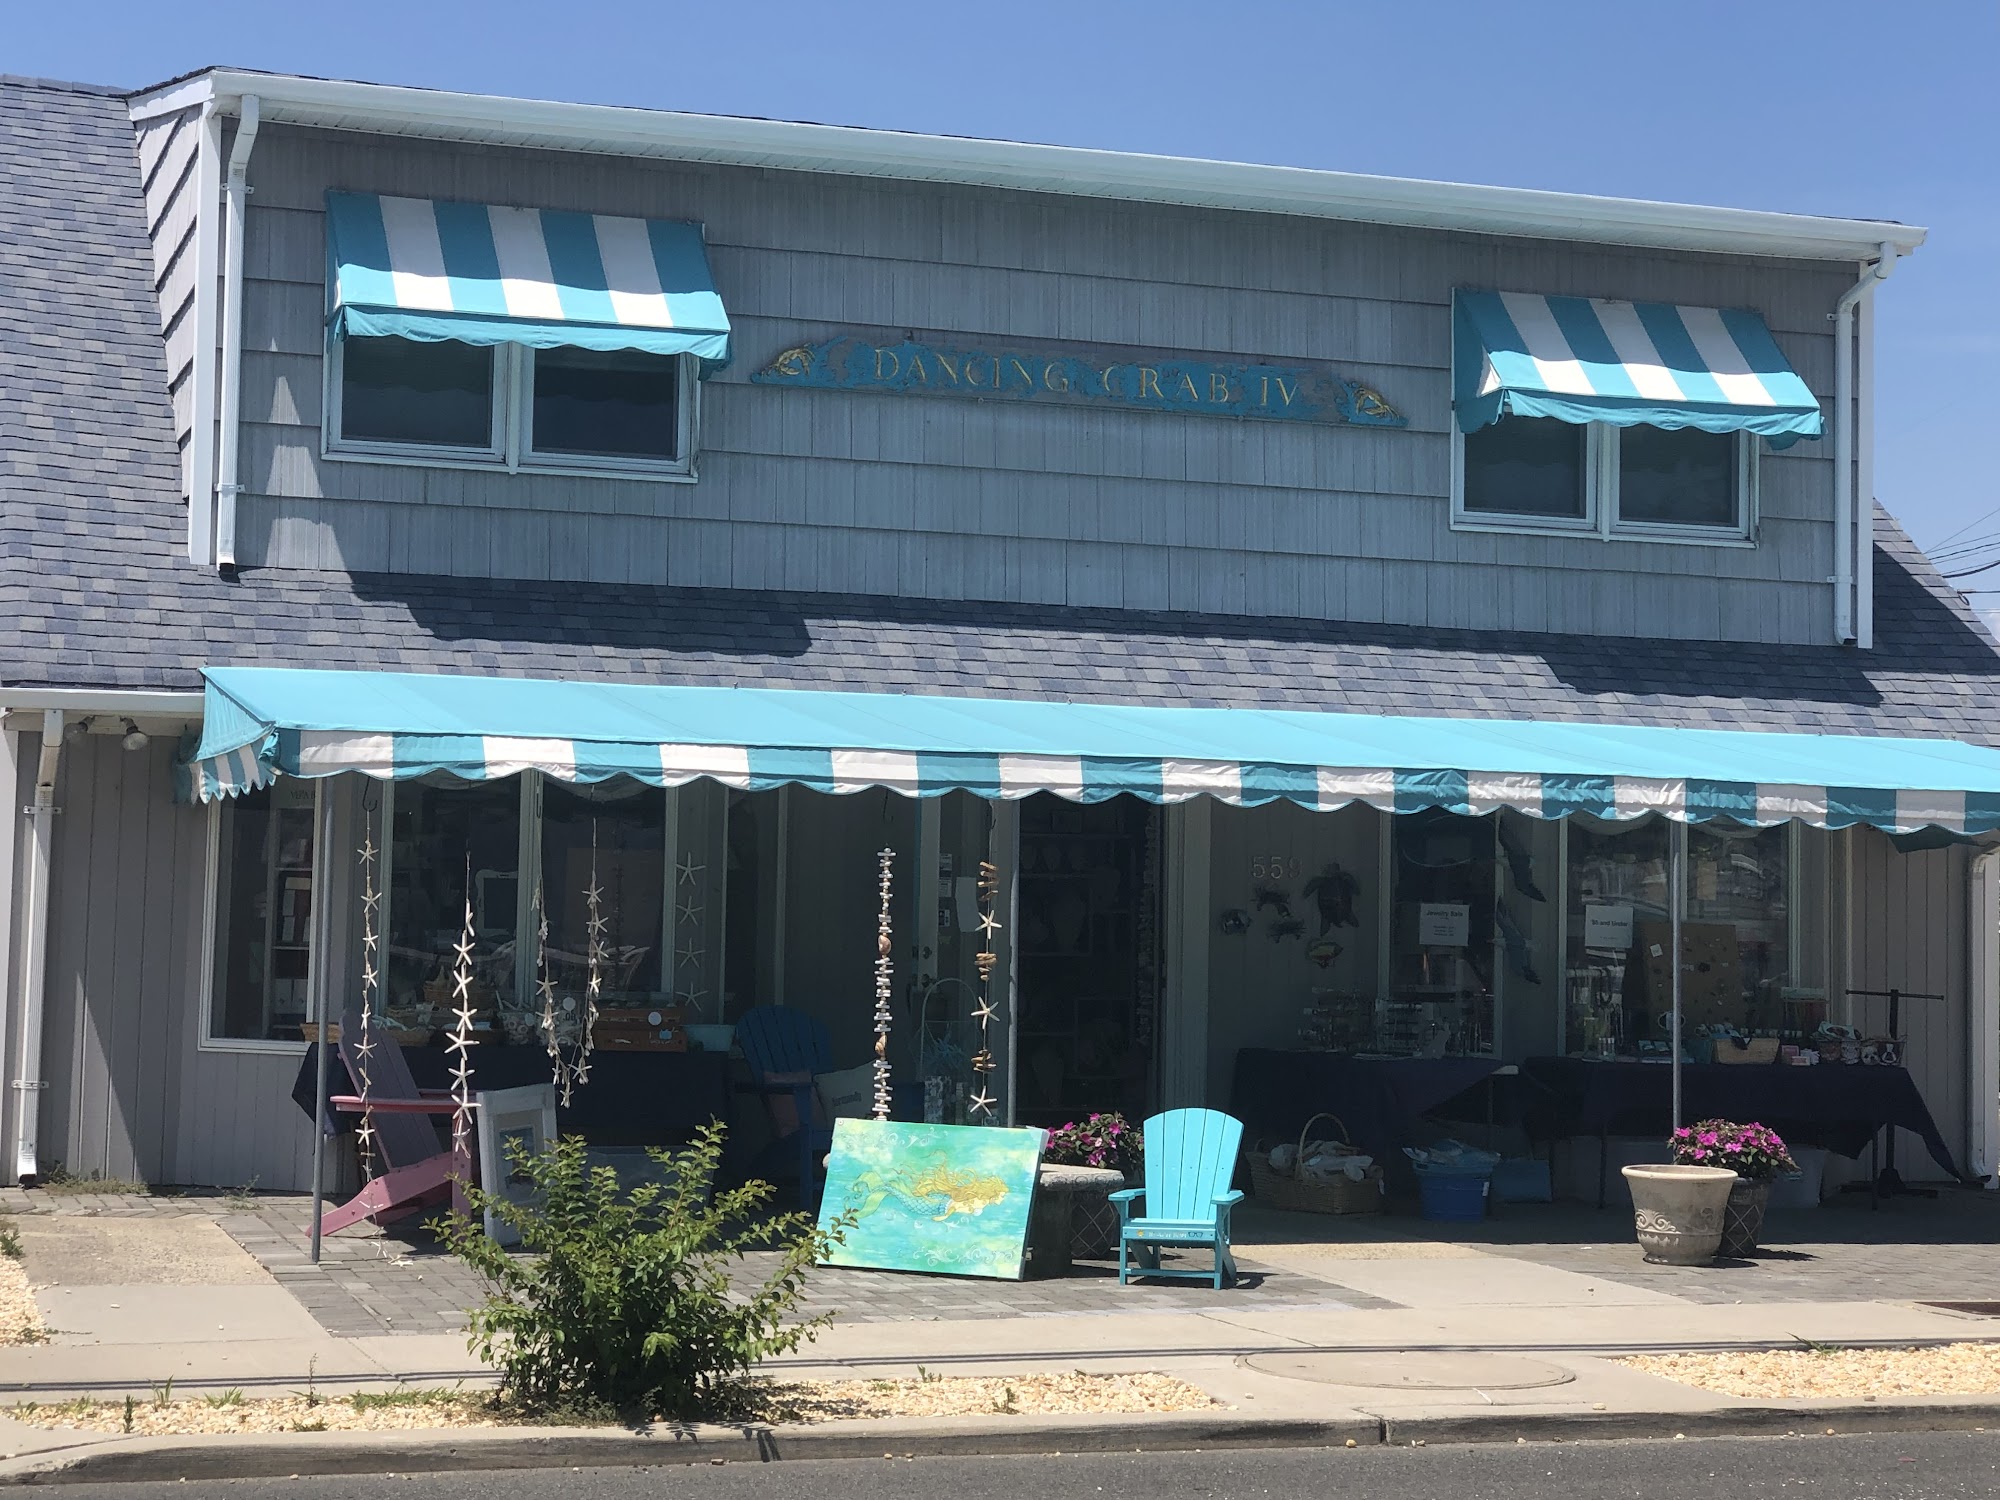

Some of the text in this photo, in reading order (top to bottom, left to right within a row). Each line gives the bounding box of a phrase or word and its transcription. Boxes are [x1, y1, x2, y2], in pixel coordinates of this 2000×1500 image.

[875, 349, 1299, 406] DANCING CRAB IV
